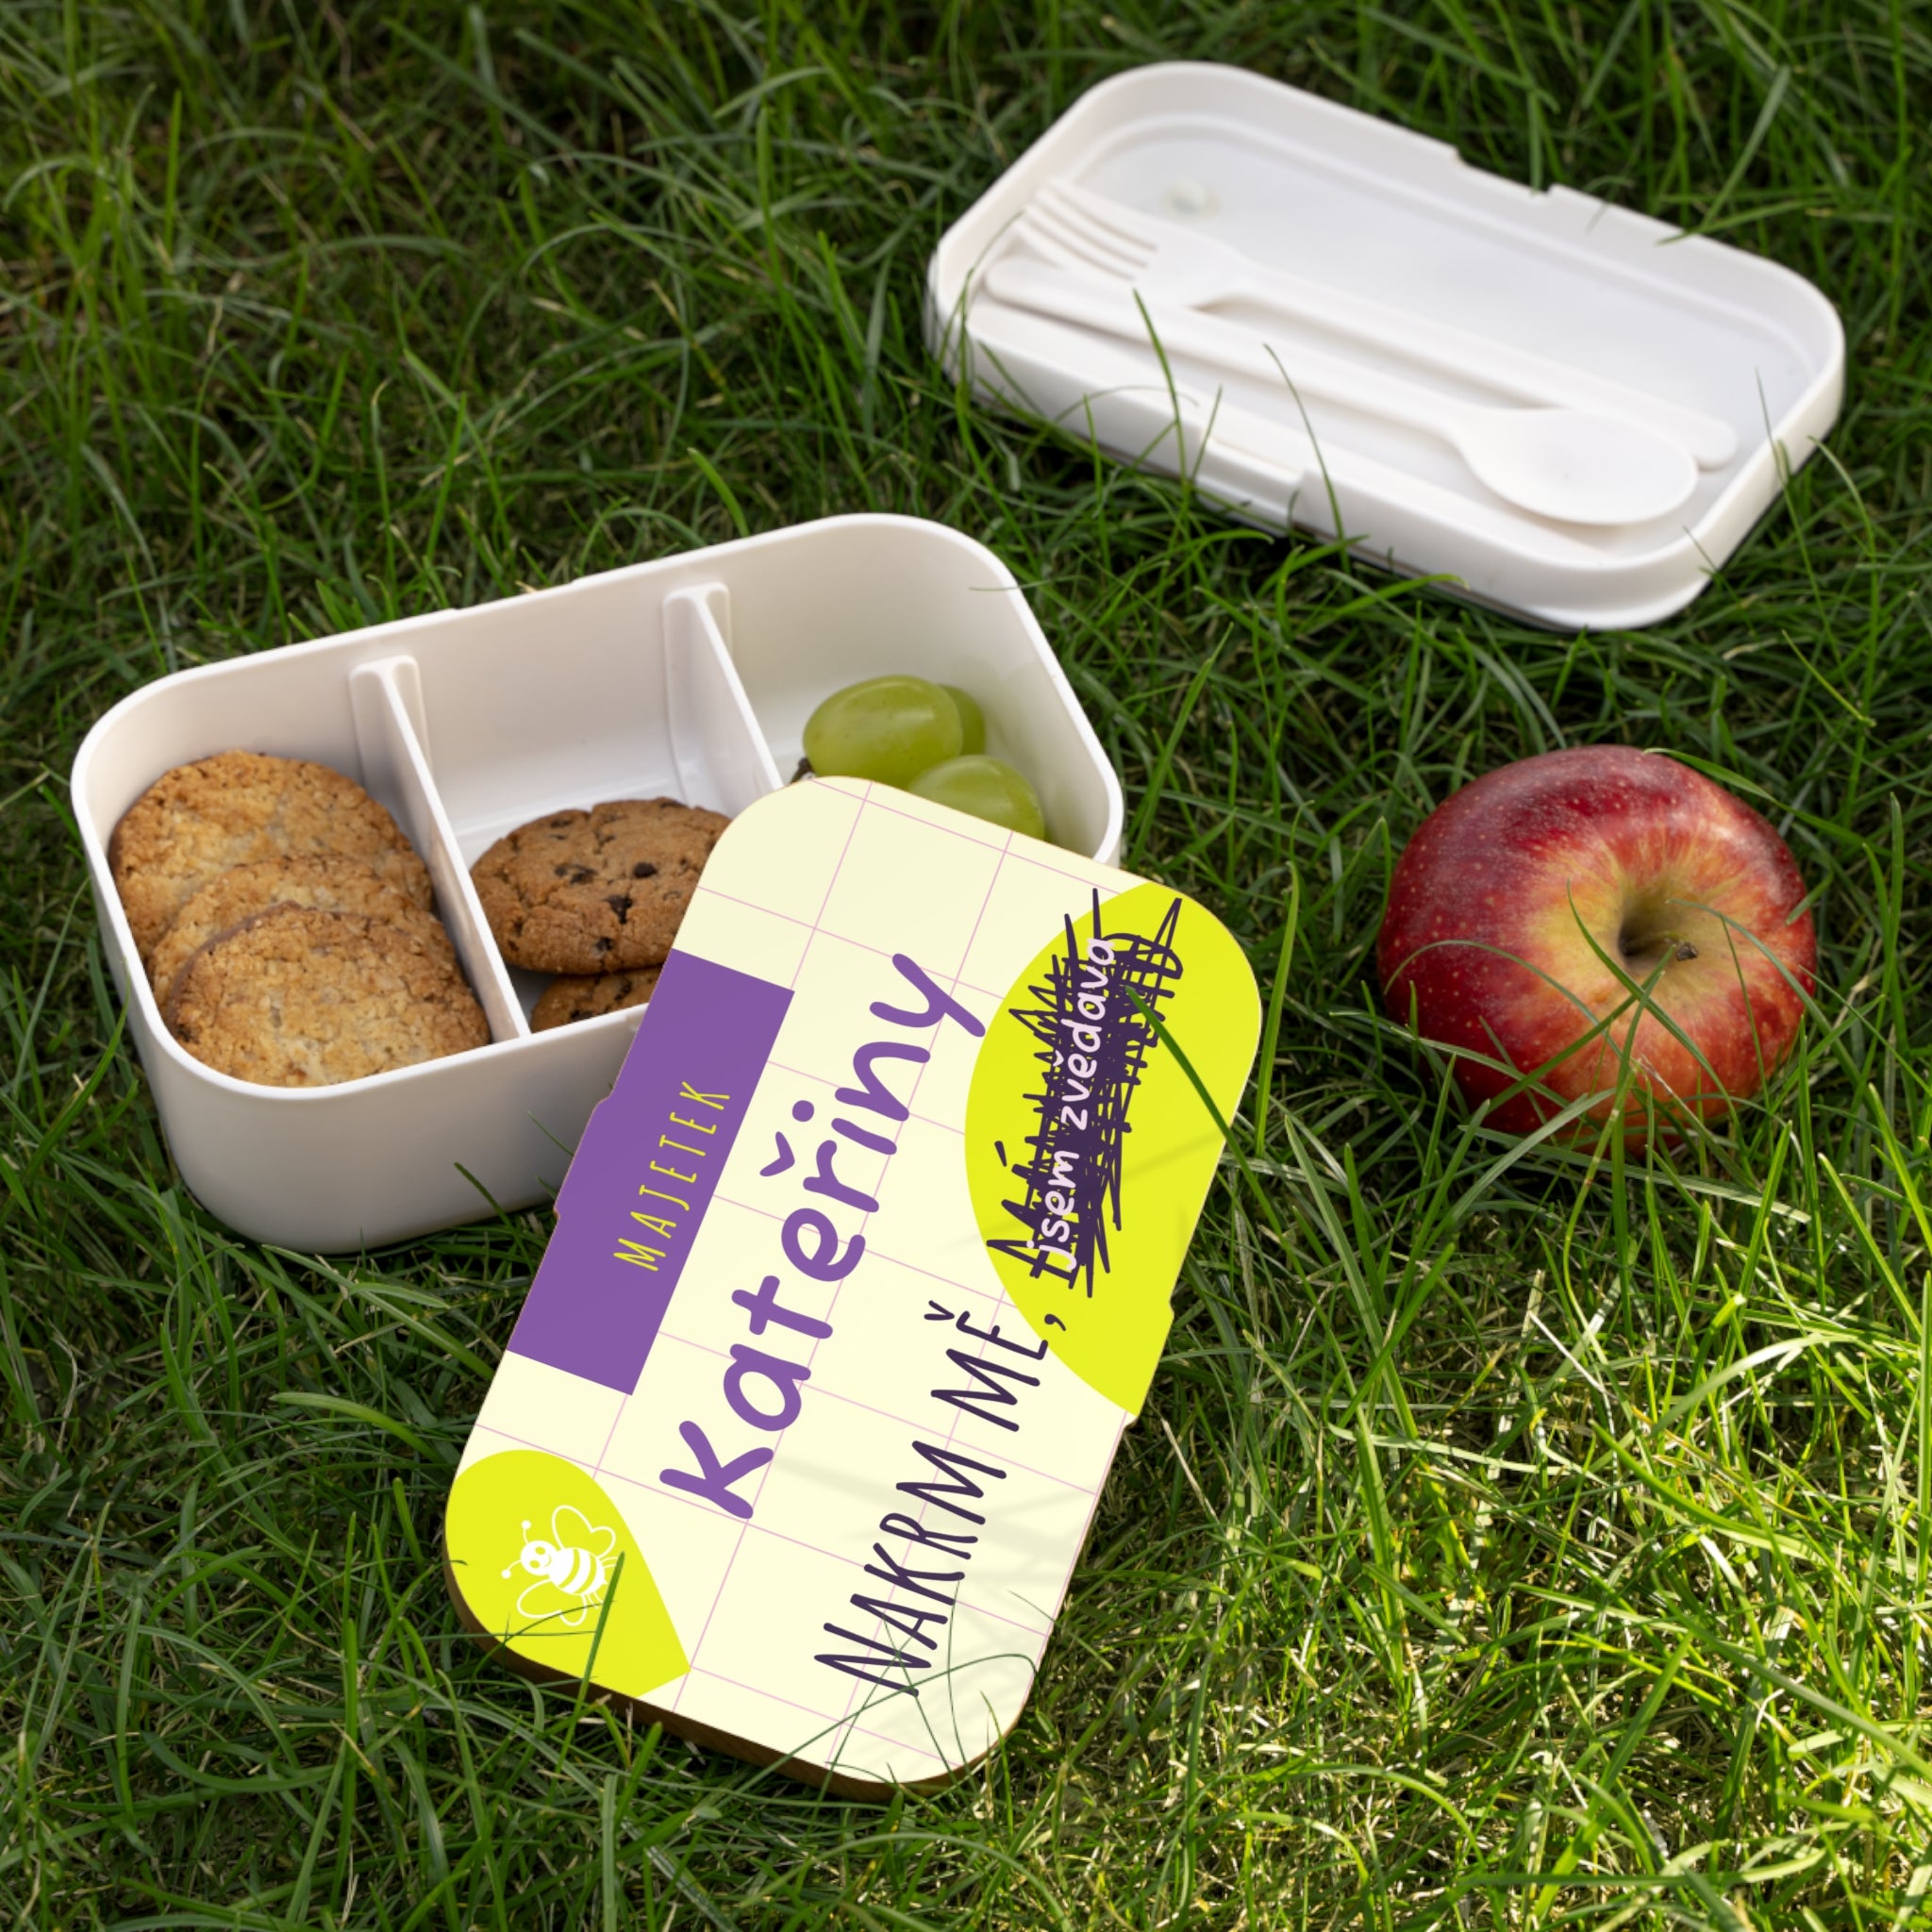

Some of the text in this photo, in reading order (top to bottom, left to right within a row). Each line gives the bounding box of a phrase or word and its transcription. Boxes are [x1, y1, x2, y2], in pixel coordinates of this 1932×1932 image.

[613, 1081, 730, 1272] MAJETEK
[658, 953, 987, 1520] Kateřiny
[1025, 937, 1117, 1272] jsem zvědava
